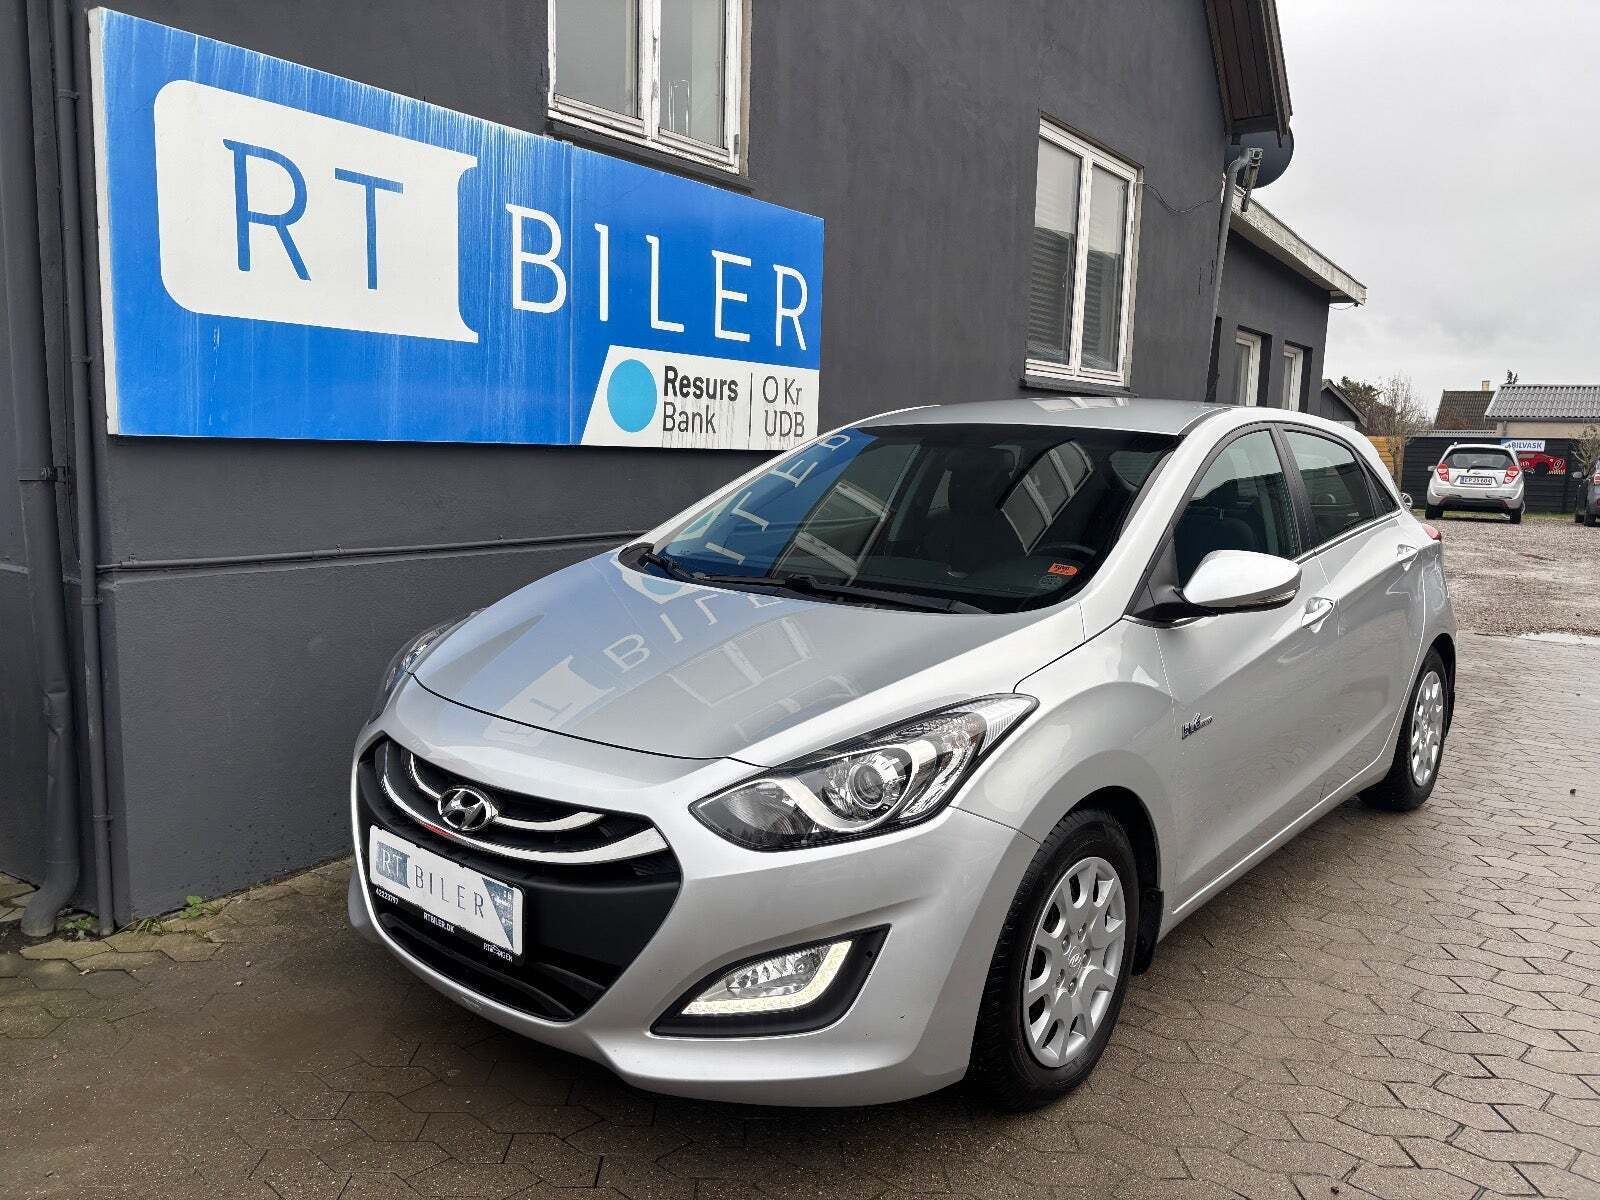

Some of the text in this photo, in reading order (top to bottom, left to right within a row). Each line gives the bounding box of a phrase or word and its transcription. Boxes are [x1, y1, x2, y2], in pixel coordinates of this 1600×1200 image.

[223, 138, 809, 351] RT BILER
[663, 365, 740, 402] Resurs
[784, 377, 803, 406] Kr
[662, 401, 717, 434] Bank
[763, 409, 806, 438] UDB
[381, 848, 402, 878] RT
[414, 864, 485, 919] BILER
